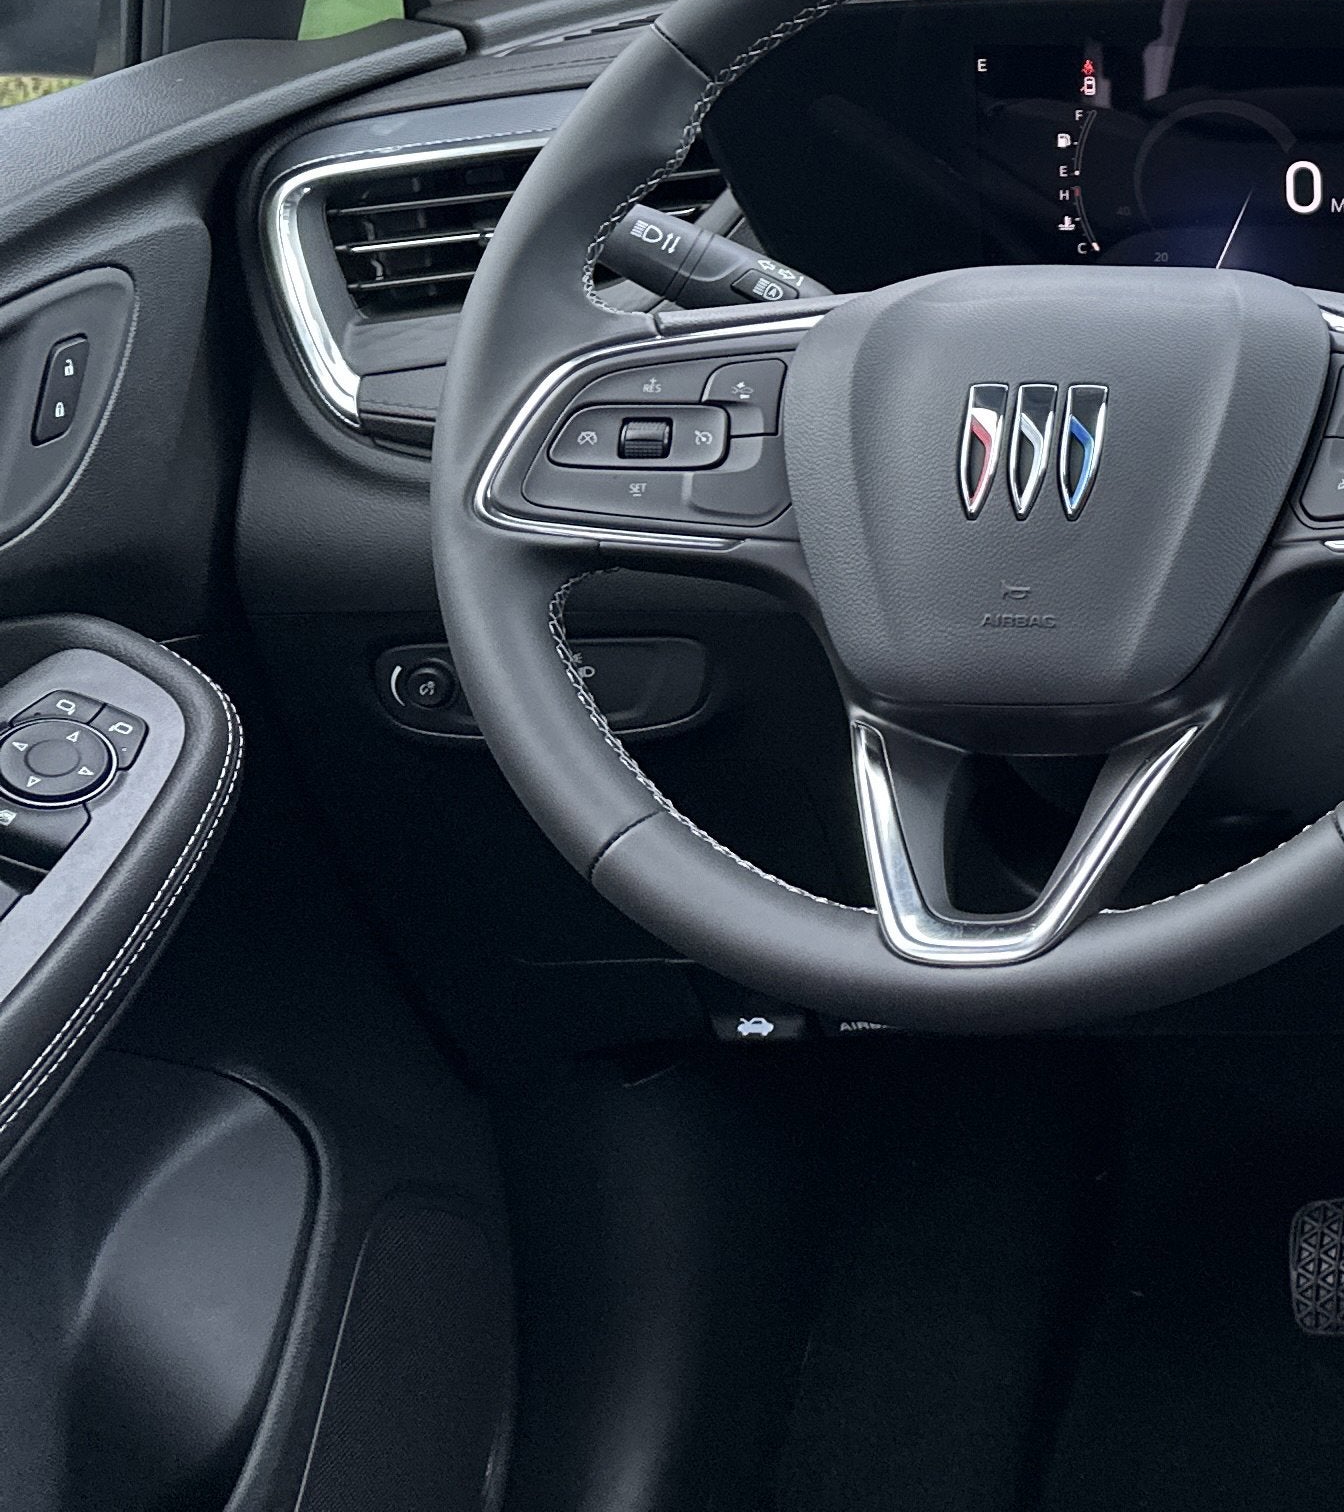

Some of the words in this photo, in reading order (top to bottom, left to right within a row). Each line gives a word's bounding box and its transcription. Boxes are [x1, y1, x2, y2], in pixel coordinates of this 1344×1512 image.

[977, 59, 986, 72] E
[1075, 110, 1083, 121] F
[1059, 166, 1067, 177] E
[1285, 160, 1322, 214] 0
[1059, 190, 1069, 200] H
[1077, 243, 1087, 254] C
[1153, 252, 1168, 264] 20
[643, 383, 662, 393] RES
[629, 482, 648, 494] SET
[981, 613, 1057, 629] AIRBAG
